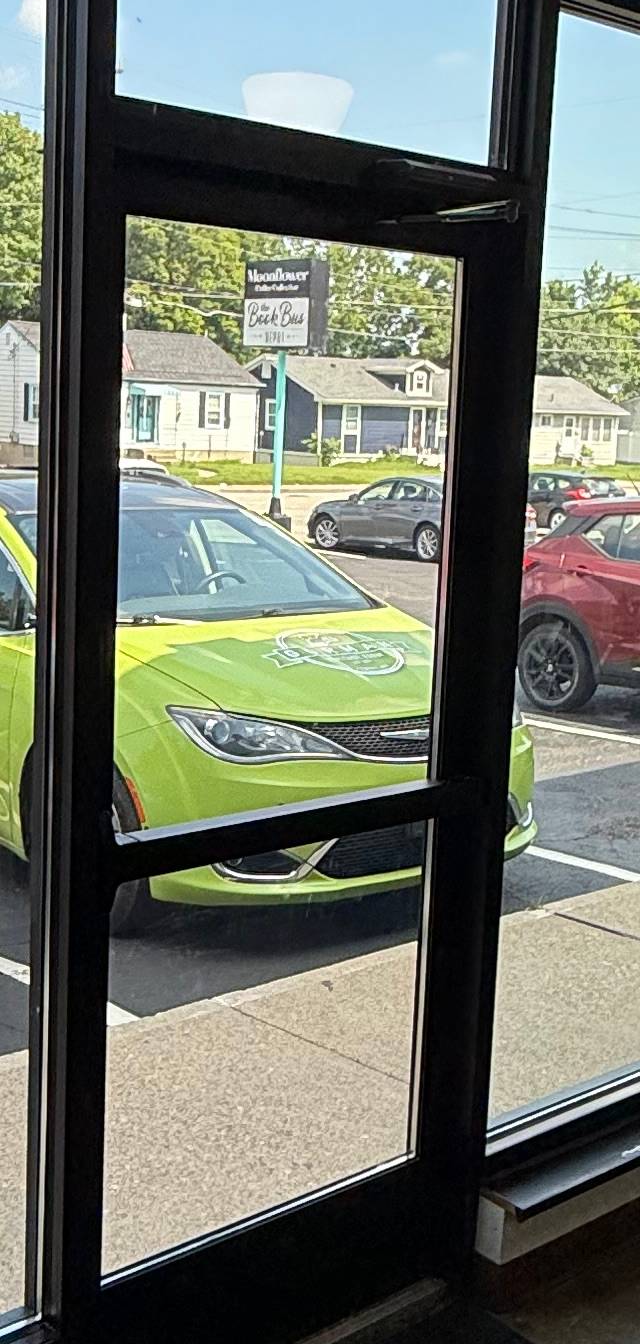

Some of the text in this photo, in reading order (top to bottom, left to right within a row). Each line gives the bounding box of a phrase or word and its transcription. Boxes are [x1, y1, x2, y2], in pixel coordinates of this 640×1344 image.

[247, 267, 309, 283] Moonflower
[247, 300, 304, 327] Book Bus
